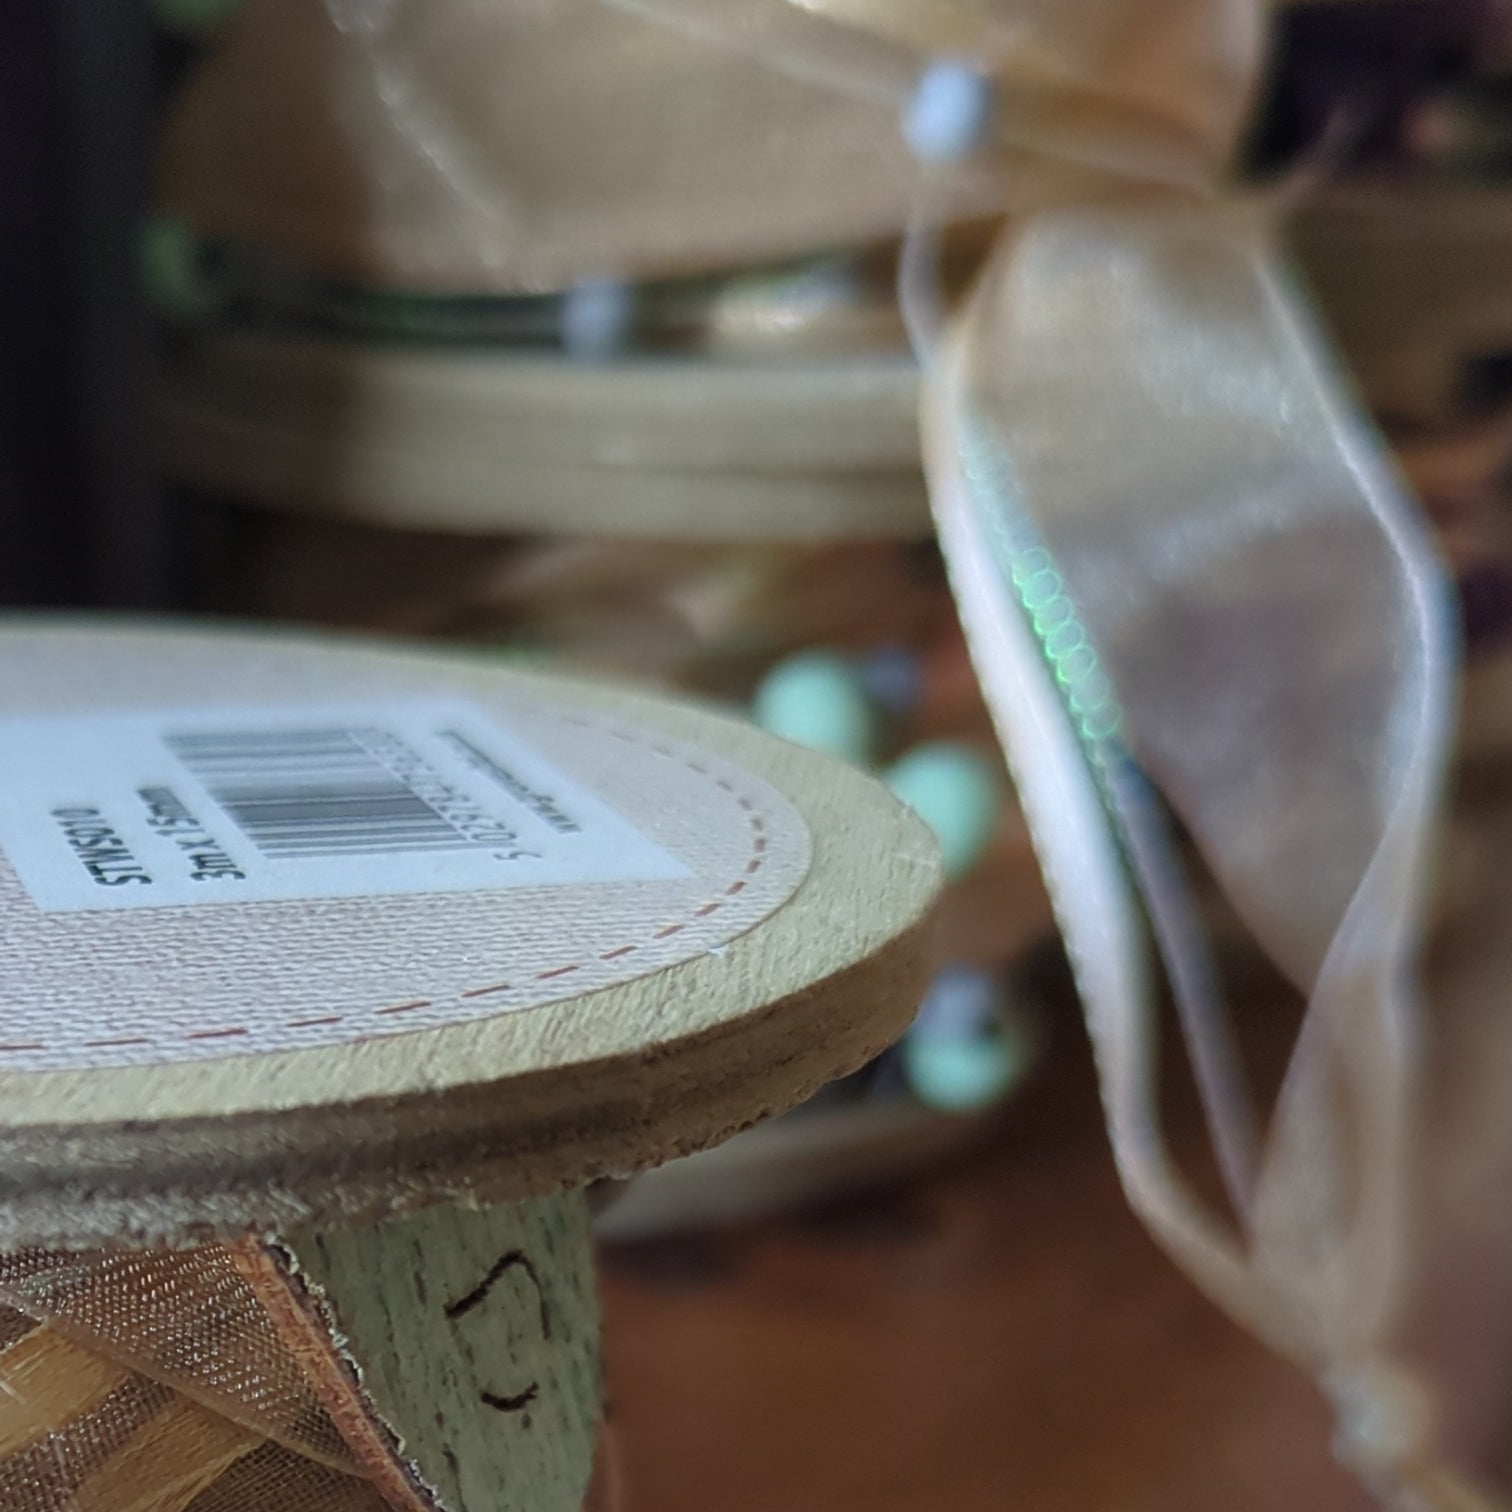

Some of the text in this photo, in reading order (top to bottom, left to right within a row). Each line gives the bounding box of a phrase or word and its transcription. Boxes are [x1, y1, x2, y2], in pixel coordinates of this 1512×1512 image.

[49, 808, 153, 886] STWS010
[175, 837, 221, 851] x
[189, 852, 246, 881] 3m
